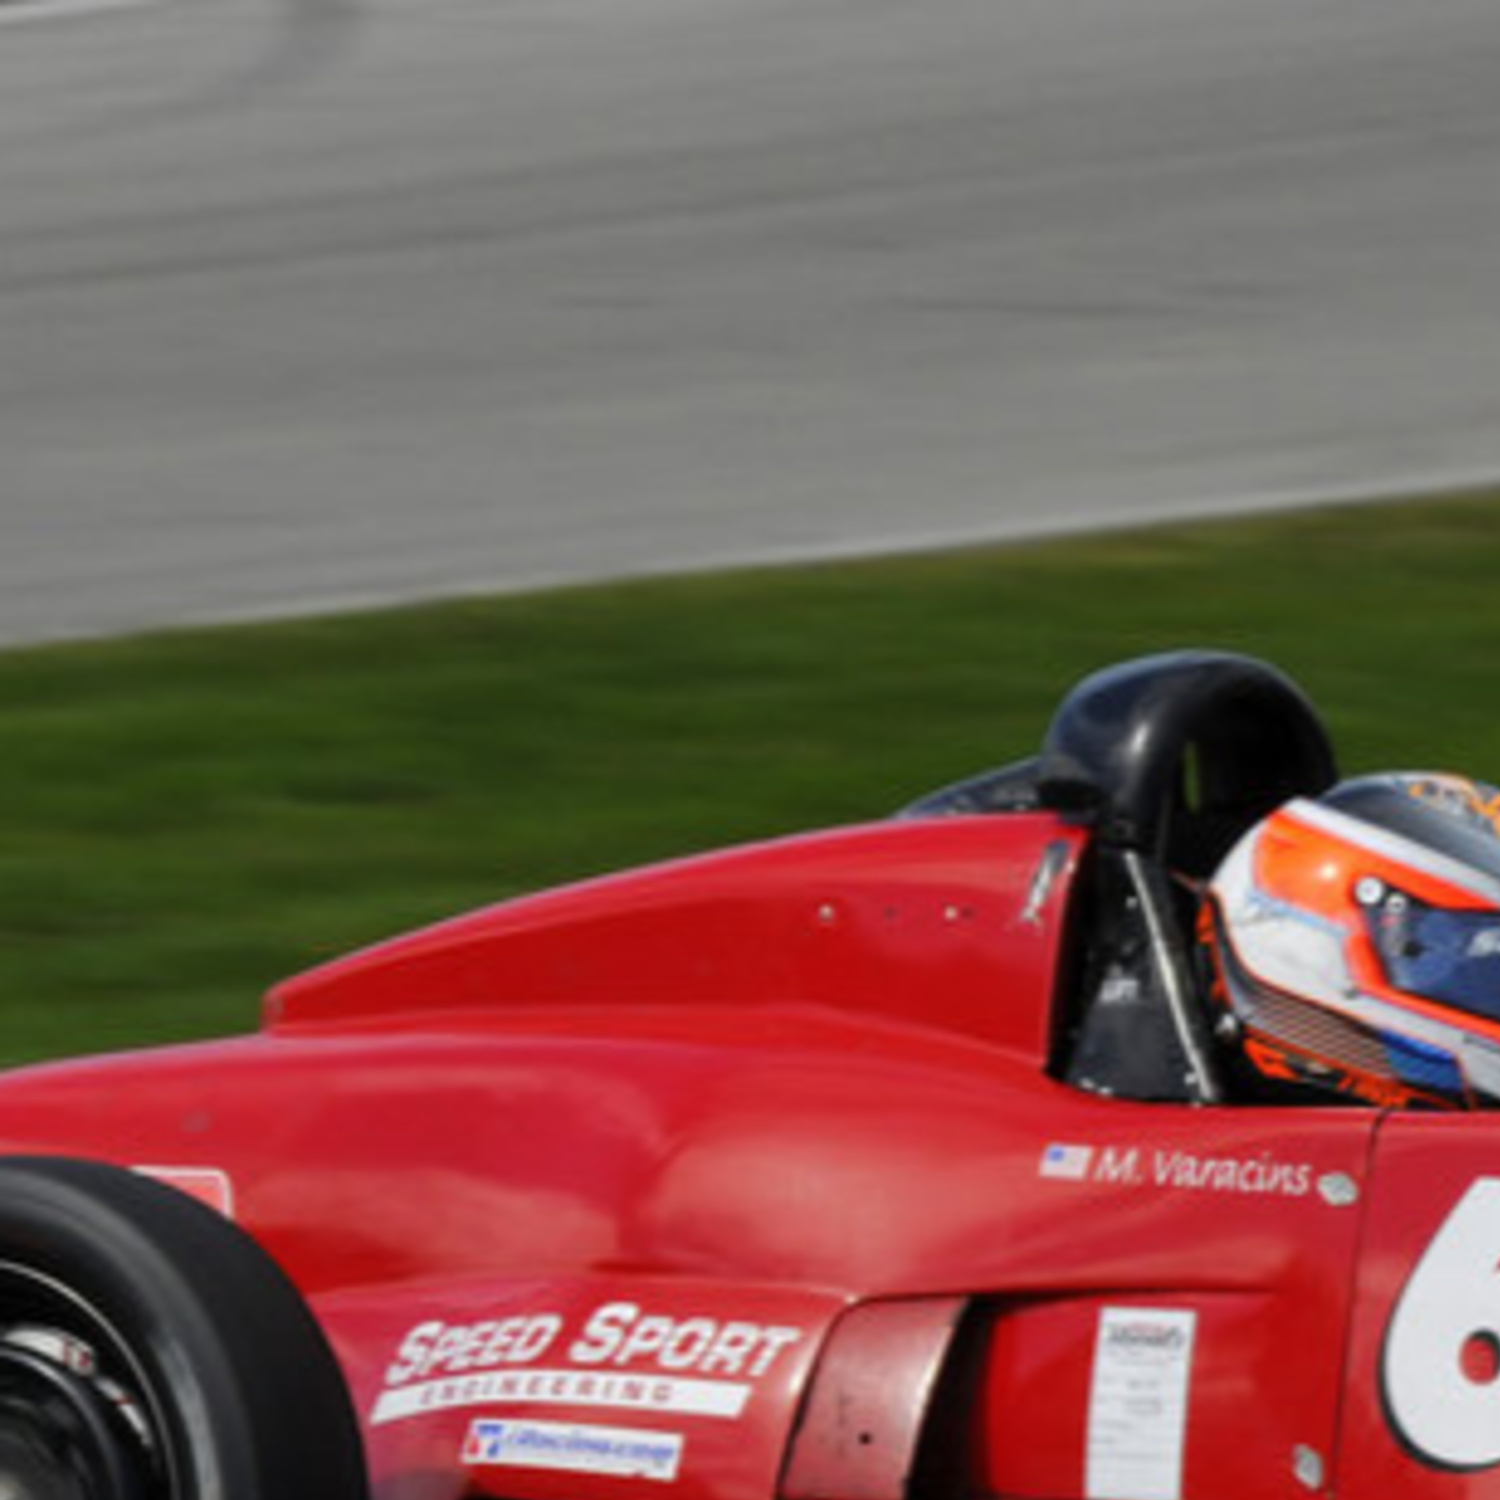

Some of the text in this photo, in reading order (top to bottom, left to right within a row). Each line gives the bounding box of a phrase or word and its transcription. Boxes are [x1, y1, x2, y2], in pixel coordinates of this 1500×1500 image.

[1096, 1147, 1313, 1195] M. Varacins
[419, 1375, 674, 1406] ENGINEERING
